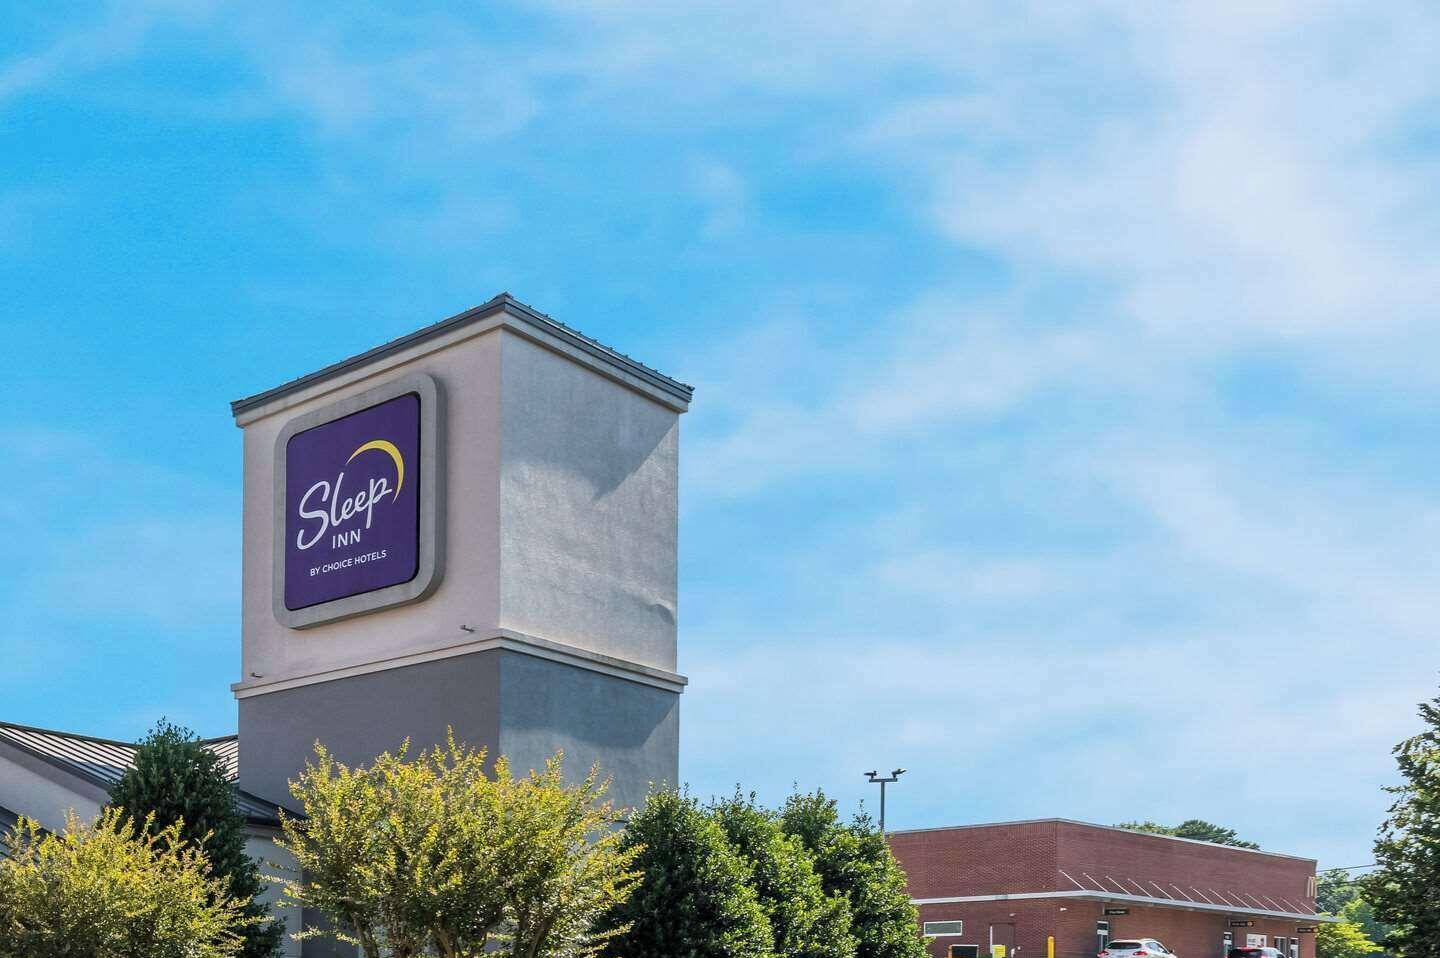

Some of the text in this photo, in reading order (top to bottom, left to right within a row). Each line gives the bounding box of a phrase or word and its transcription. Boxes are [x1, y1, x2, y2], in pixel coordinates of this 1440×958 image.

[297, 472, 392, 550] Sleep
[332, 528, 361, 549] INN
[310, 549, 387, 577] BY CHOICE HOTELS
